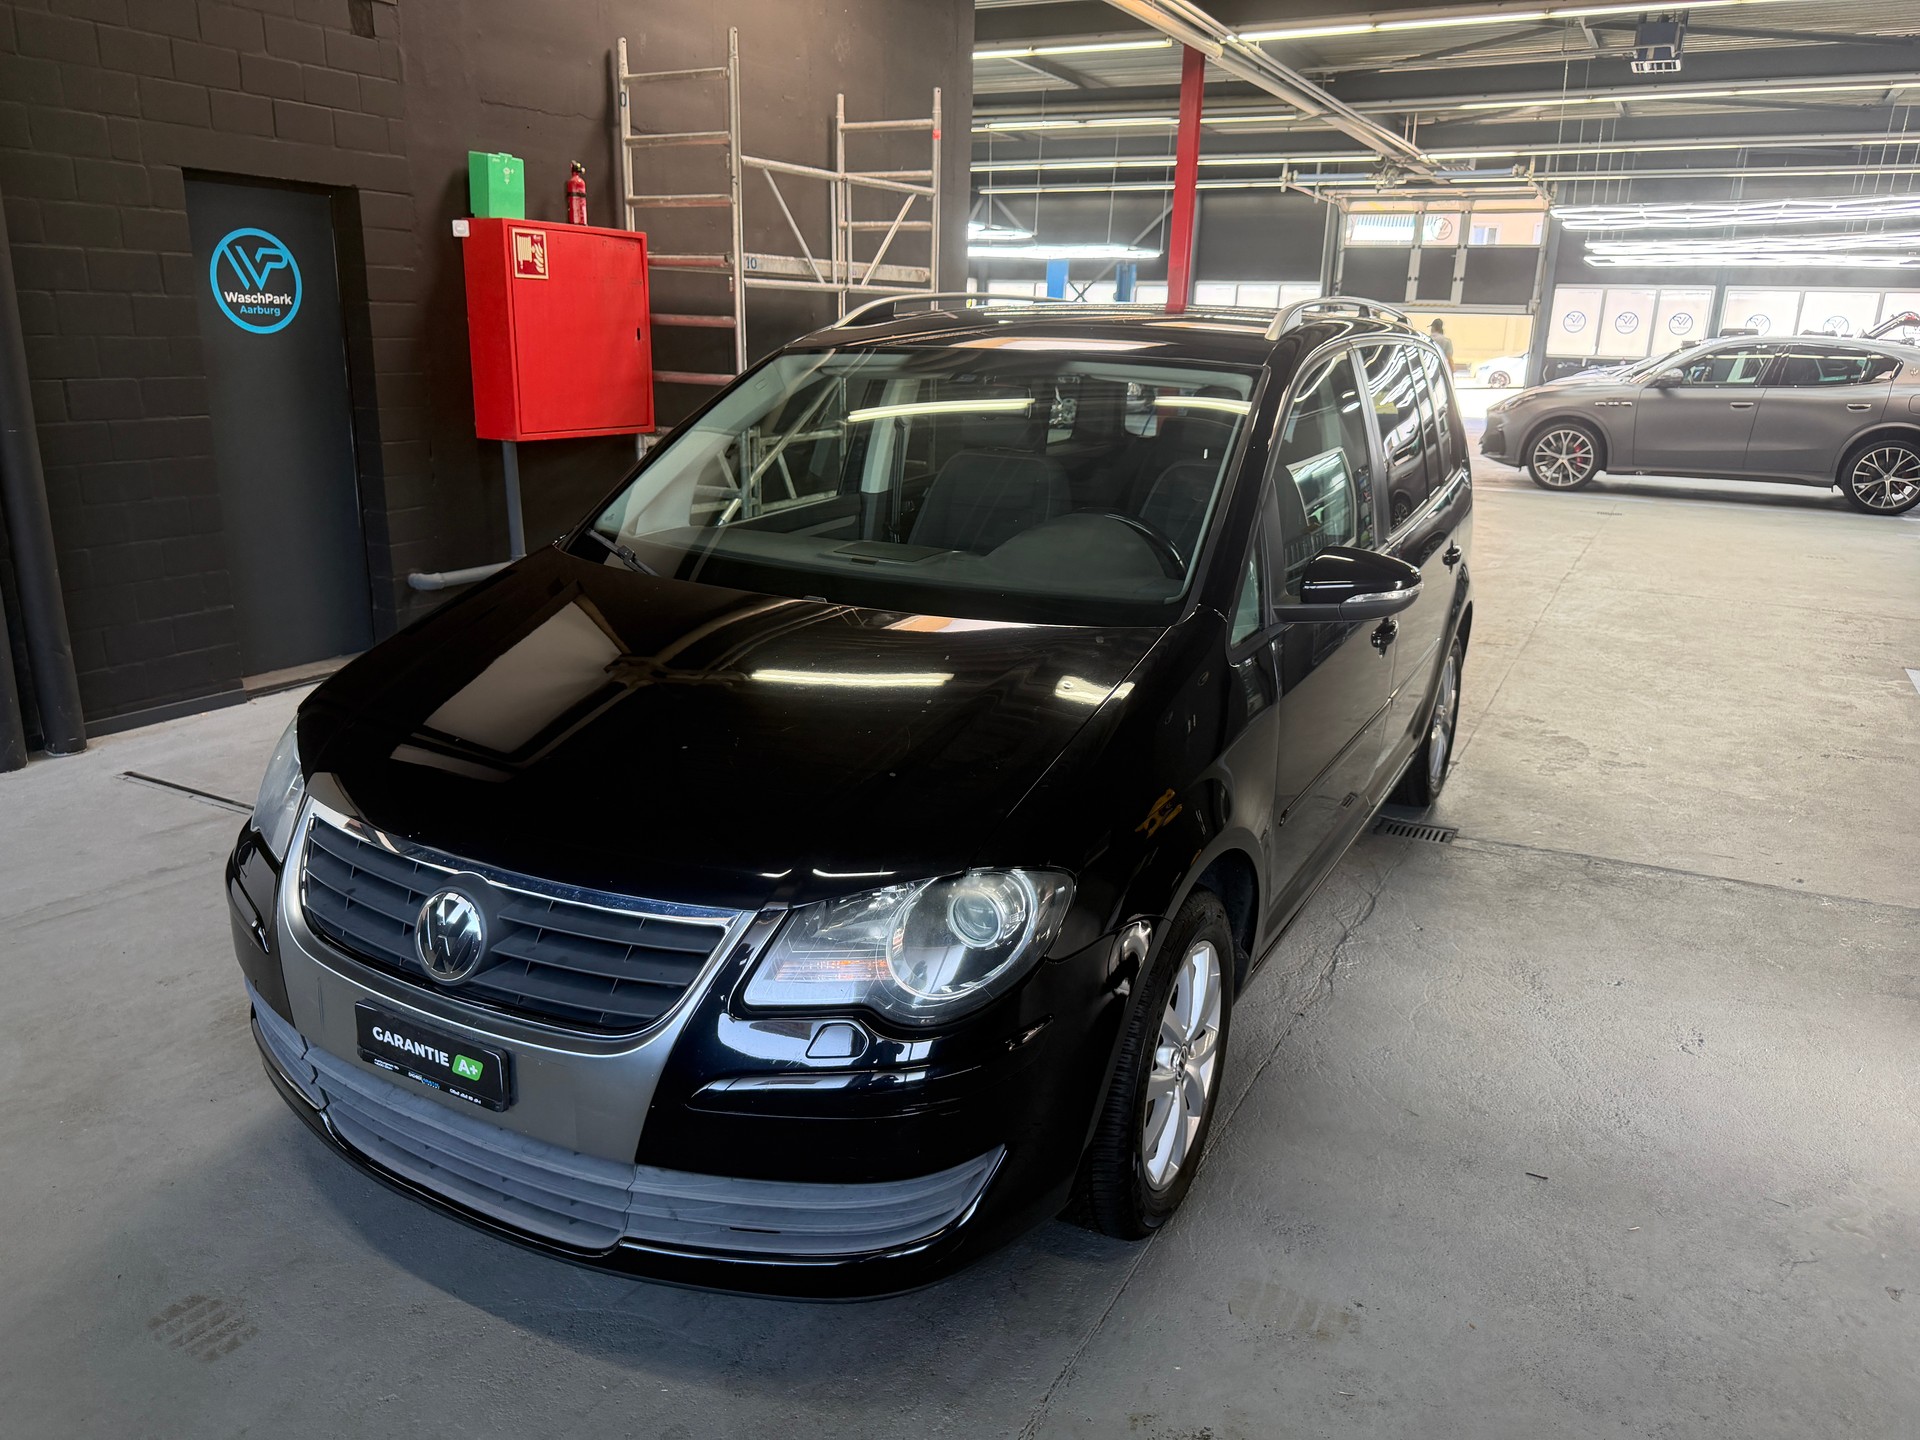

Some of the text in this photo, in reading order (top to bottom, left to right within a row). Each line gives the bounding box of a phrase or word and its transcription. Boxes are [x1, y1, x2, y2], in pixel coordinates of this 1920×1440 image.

[747, 257, 757, 269] 10
[224, 291, 292, 305] WaschPark
[240, 305, 280, 316] Aarburg
[371, 1027, 450, 1067] GARANTIE
[457, 1058, 479, 1076] A+
